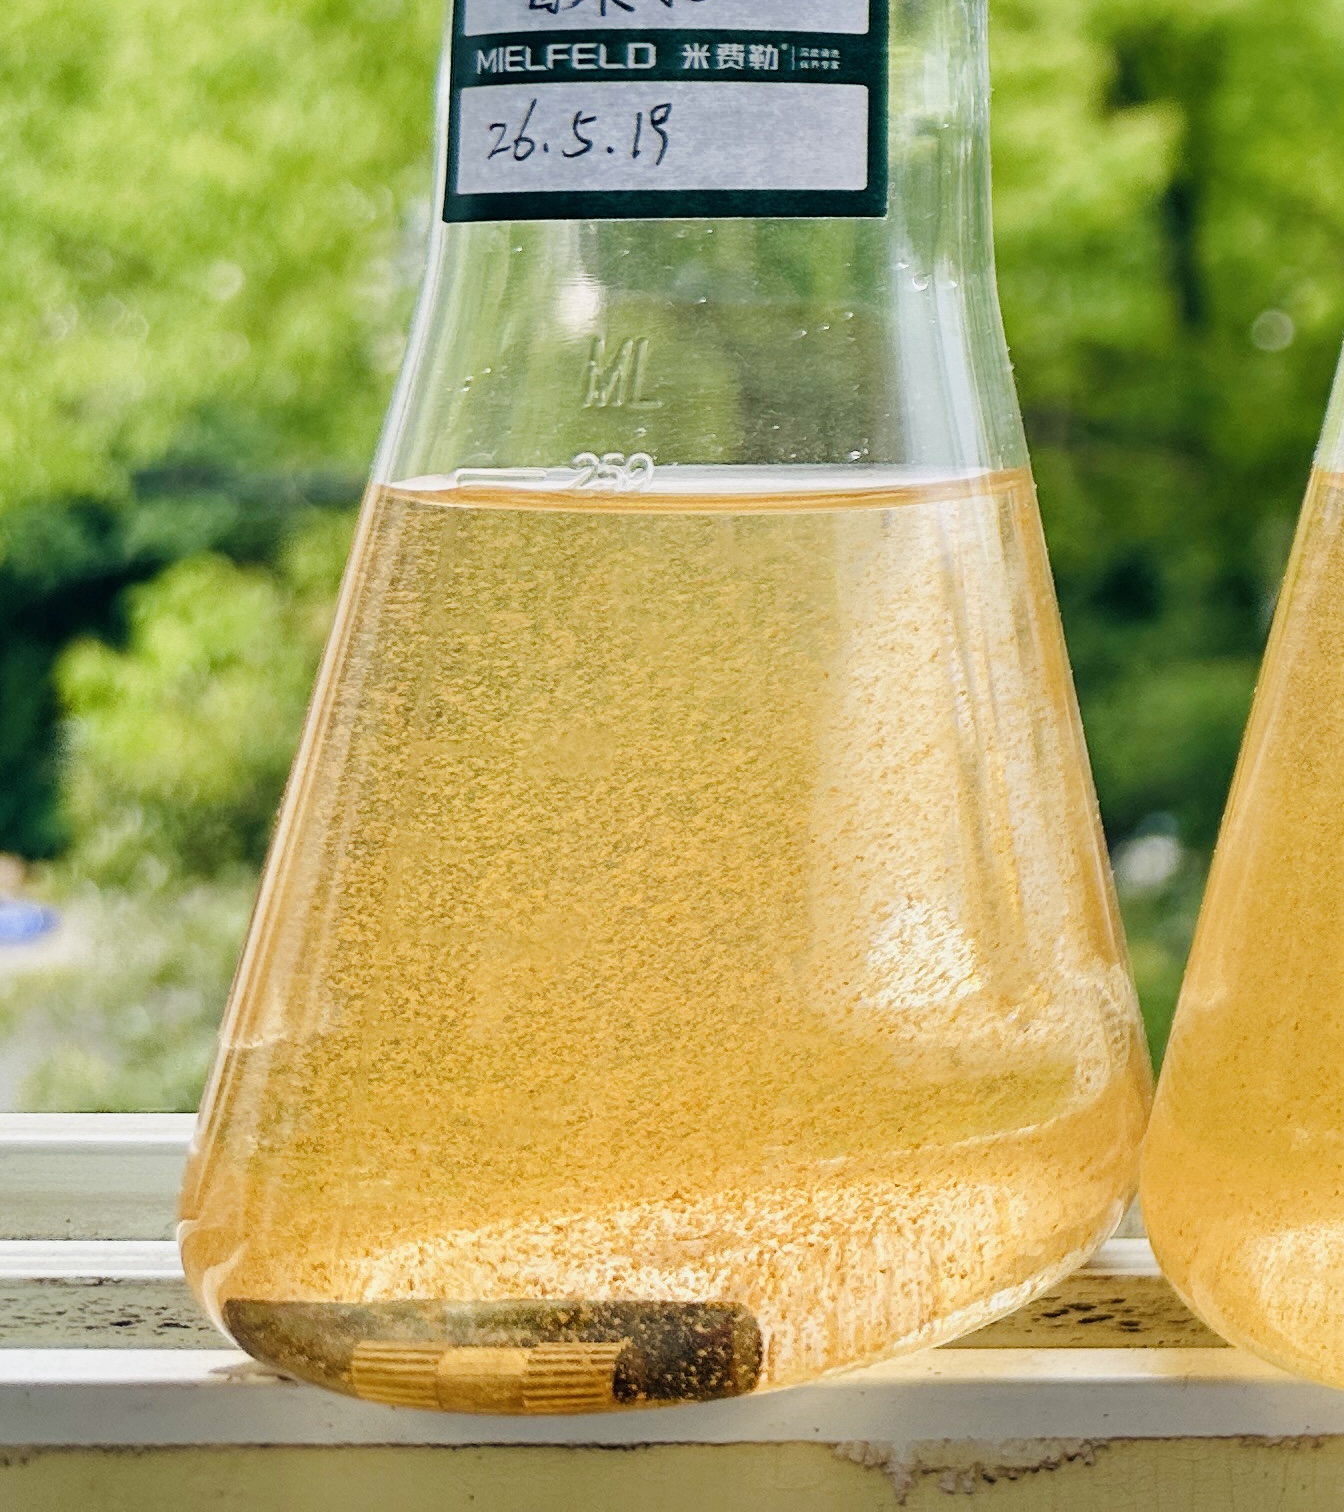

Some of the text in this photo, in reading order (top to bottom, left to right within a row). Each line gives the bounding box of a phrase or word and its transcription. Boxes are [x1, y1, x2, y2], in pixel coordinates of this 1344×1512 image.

[476, 42, 779, 75] MIELFELD 米费勒
[487, 98, 673, 166] 26.5.19
[581, 337, 664, 408] ML
